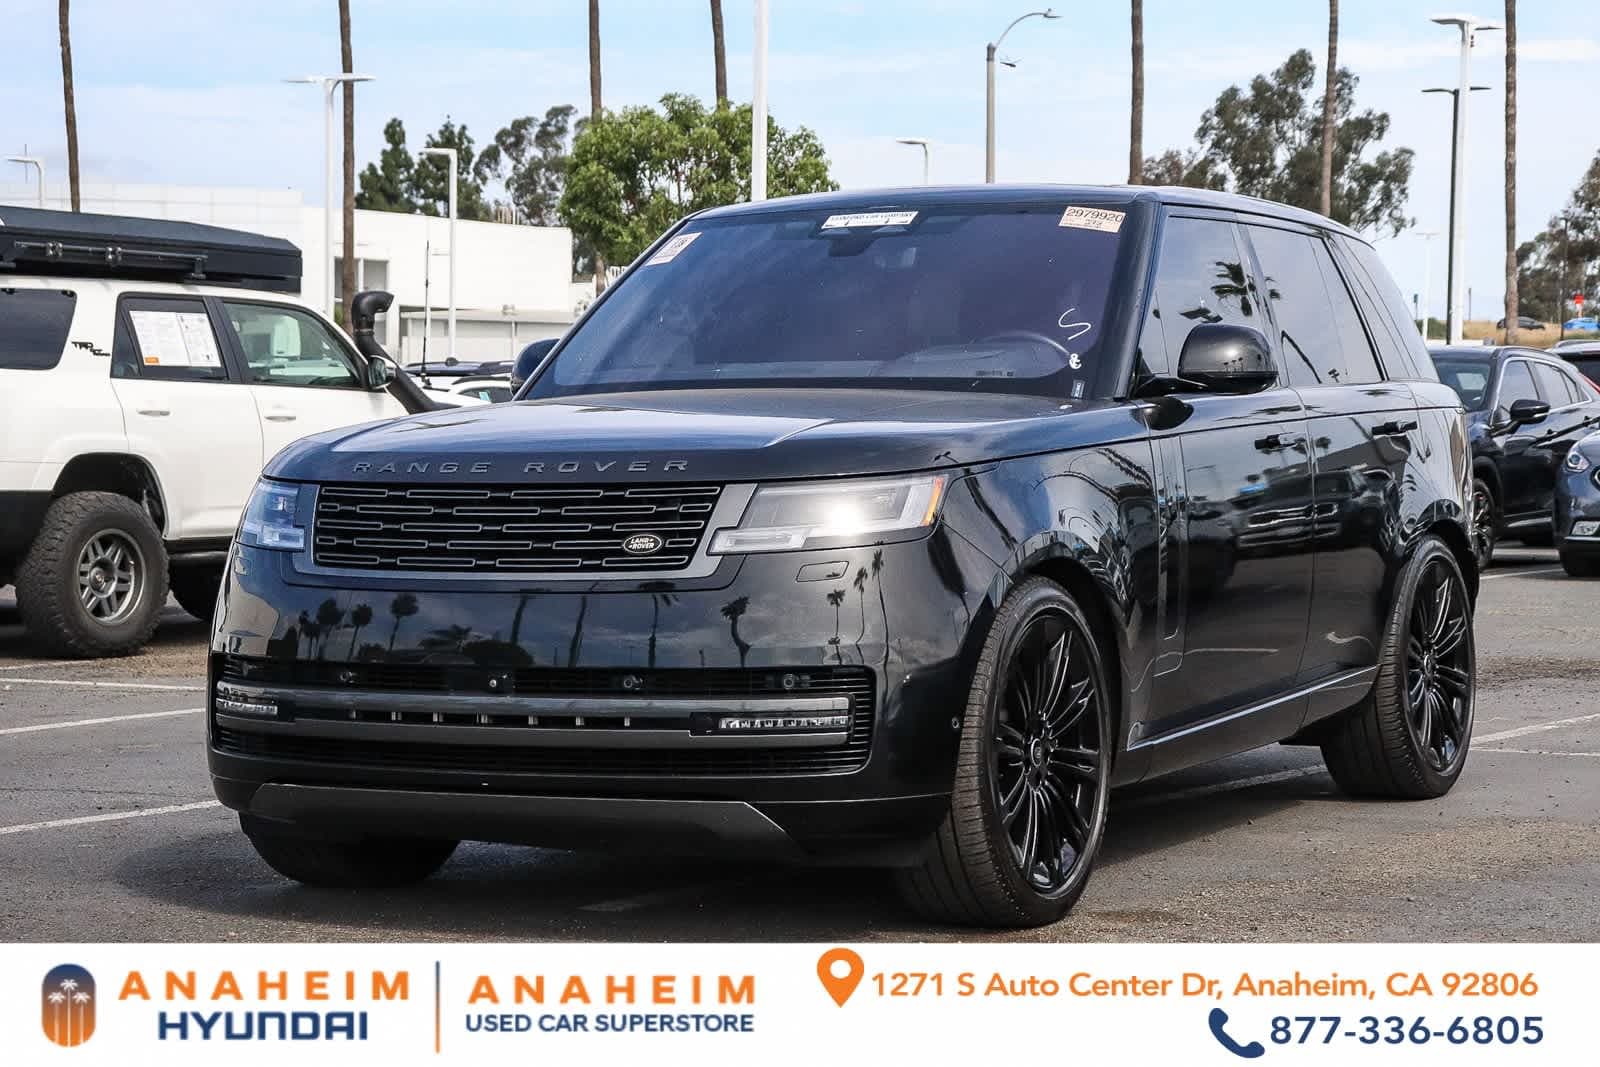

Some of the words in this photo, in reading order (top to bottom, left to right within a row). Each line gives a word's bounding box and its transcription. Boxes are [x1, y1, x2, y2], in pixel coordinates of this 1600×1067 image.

[1066, 208, 1124, 222] 2979920
[353, 462, 491, 473] RANGE
[524, 460, 688, 473] ROVER
[632, 542, 655, 550] ROVER
